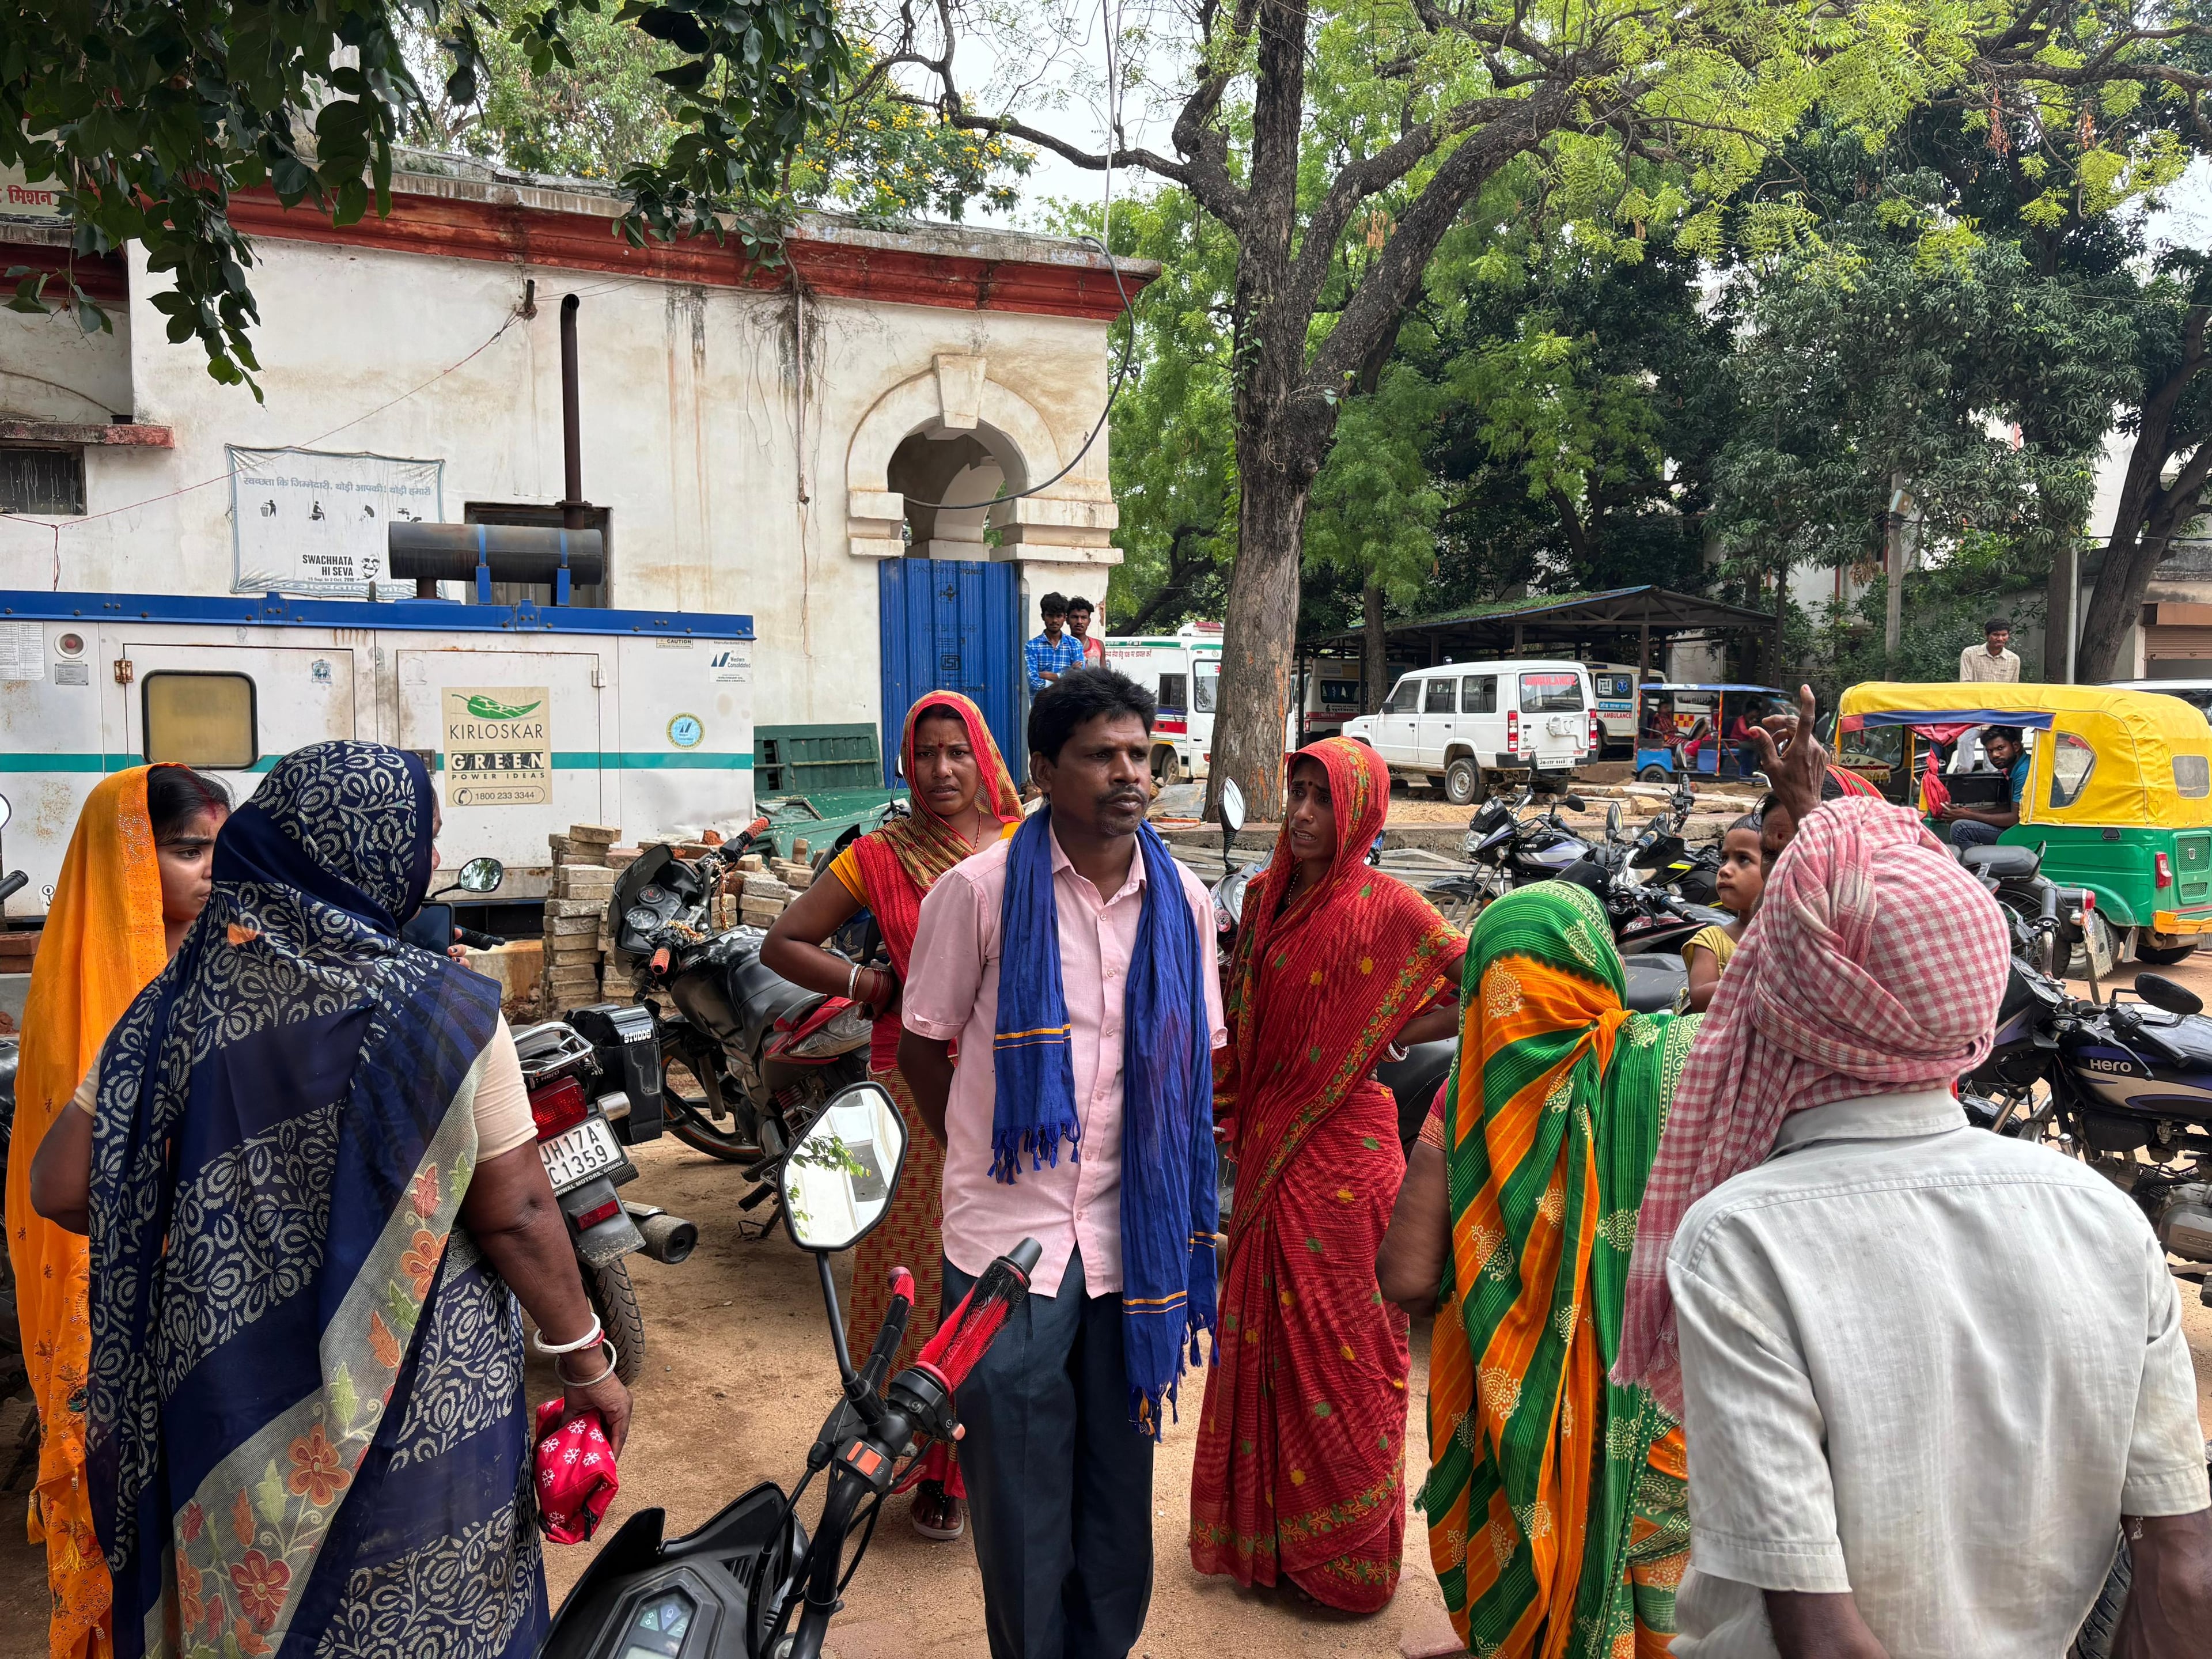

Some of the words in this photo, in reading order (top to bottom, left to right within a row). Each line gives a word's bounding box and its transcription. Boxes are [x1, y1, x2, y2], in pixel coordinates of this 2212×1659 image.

[7, 185, 53, 205] मिशन
[302, 554, 353, 566] SWACHHATA
[321, 567, 331, 575] HI
[332, 567, 354, 577] SEVA
[1525, 675, 1577, 686] AMBULANCE
[449, 724, 543, 740] KIRLOSKAR
[452, 753, 544, 770] GREEN
[1627, 922, 1643, 931] TVS
[624, 1029, 652, 1043] STUDDS
[2090, 1059, 2132, 1073] Hero
[541, 1070, 559, 1081] Hero
[543, 1126, 600, 1165] JH17A
[548, 1145, 608, 1185] C1359
[575, 1171, 604, 1187] MOTORS,
[604, 1160, 624, 1173] GODDA
